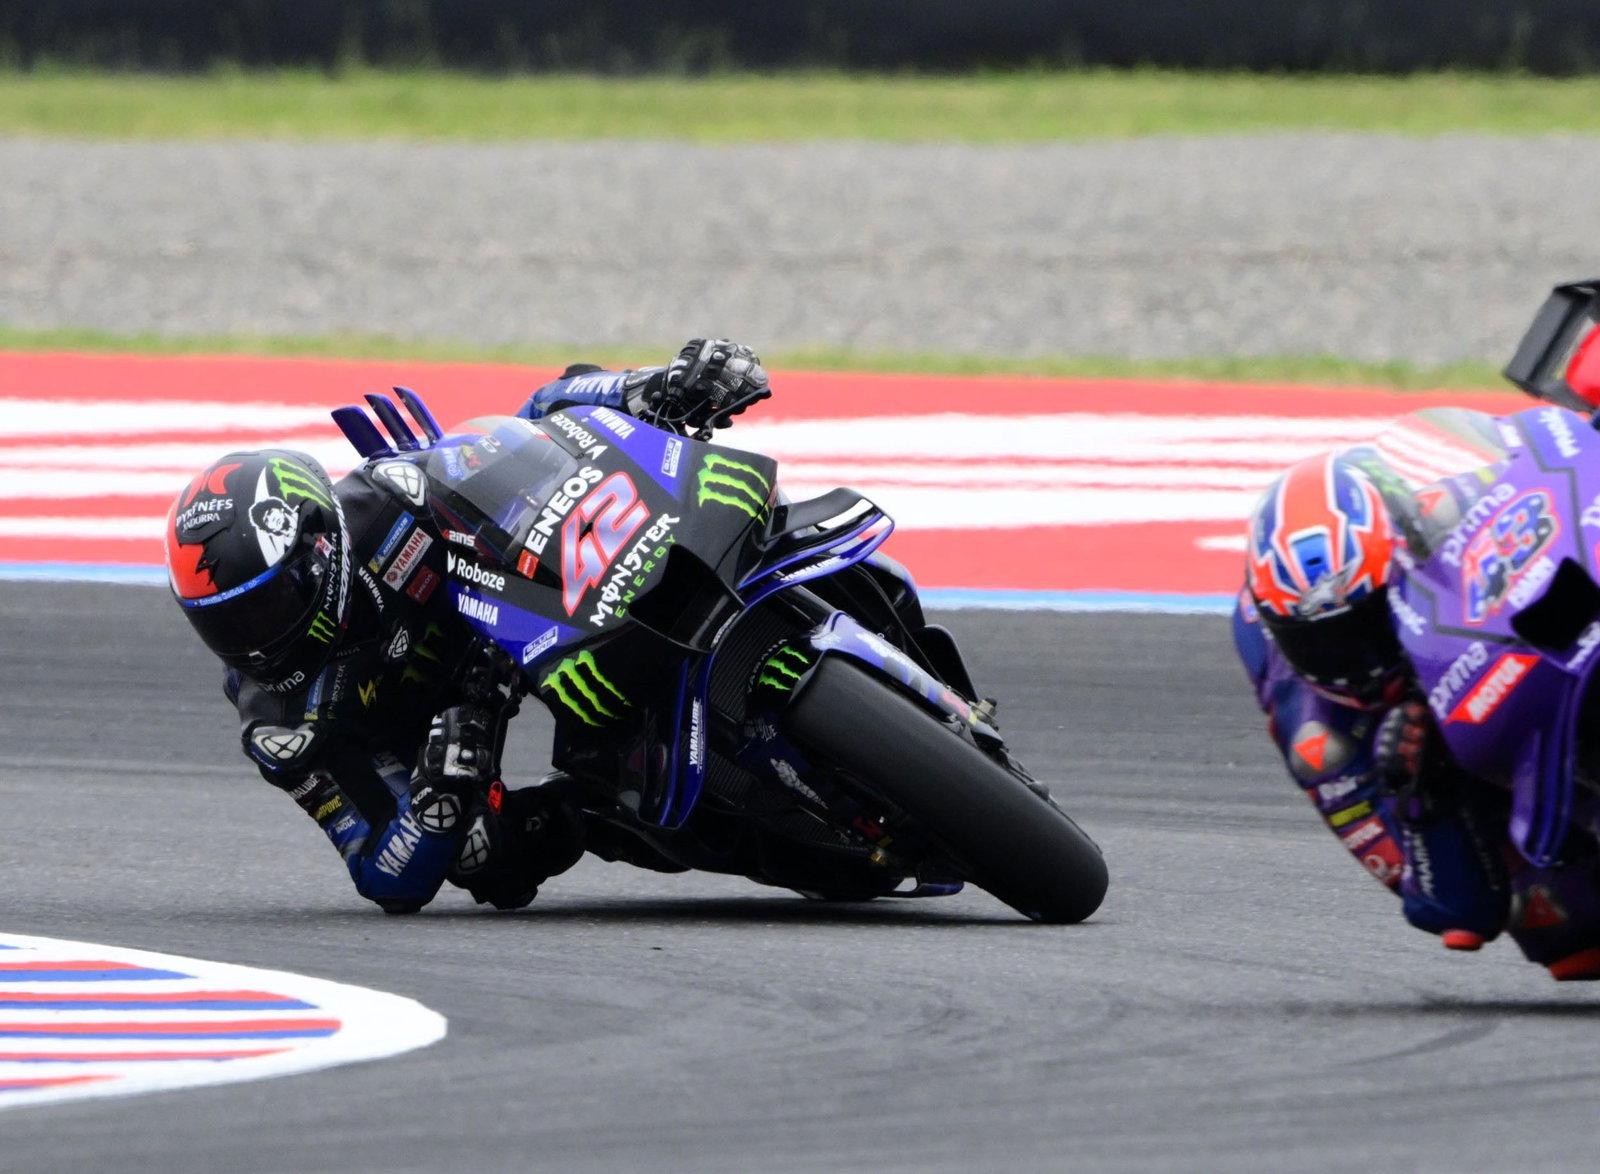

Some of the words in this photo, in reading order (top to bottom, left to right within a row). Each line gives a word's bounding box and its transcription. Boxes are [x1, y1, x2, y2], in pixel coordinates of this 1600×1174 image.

[551, 413, 597, 450] Roboze
[590, 406, 636, 440] YAMAHA
[525, 466, 604, 555] ENEOS
[561, 471, 652, 617] 42
[1441, 482, 1518, 567] prima
[393, 530, 427, 572] YAMAHA
[456, 557, 506, 592] Roboze
[589, 513, 681, 627] MONSTER
[614, 533, 677, 619] ENERGY
[457, 592, 499, 627] YAMAHA
[1428, 641, 1488, 719] prima
[1465, 656, 1527, 722] MOTUL
[689, 697, 701, 765] YAMALUBE
[375, 811, 424, 877] YAMAH
